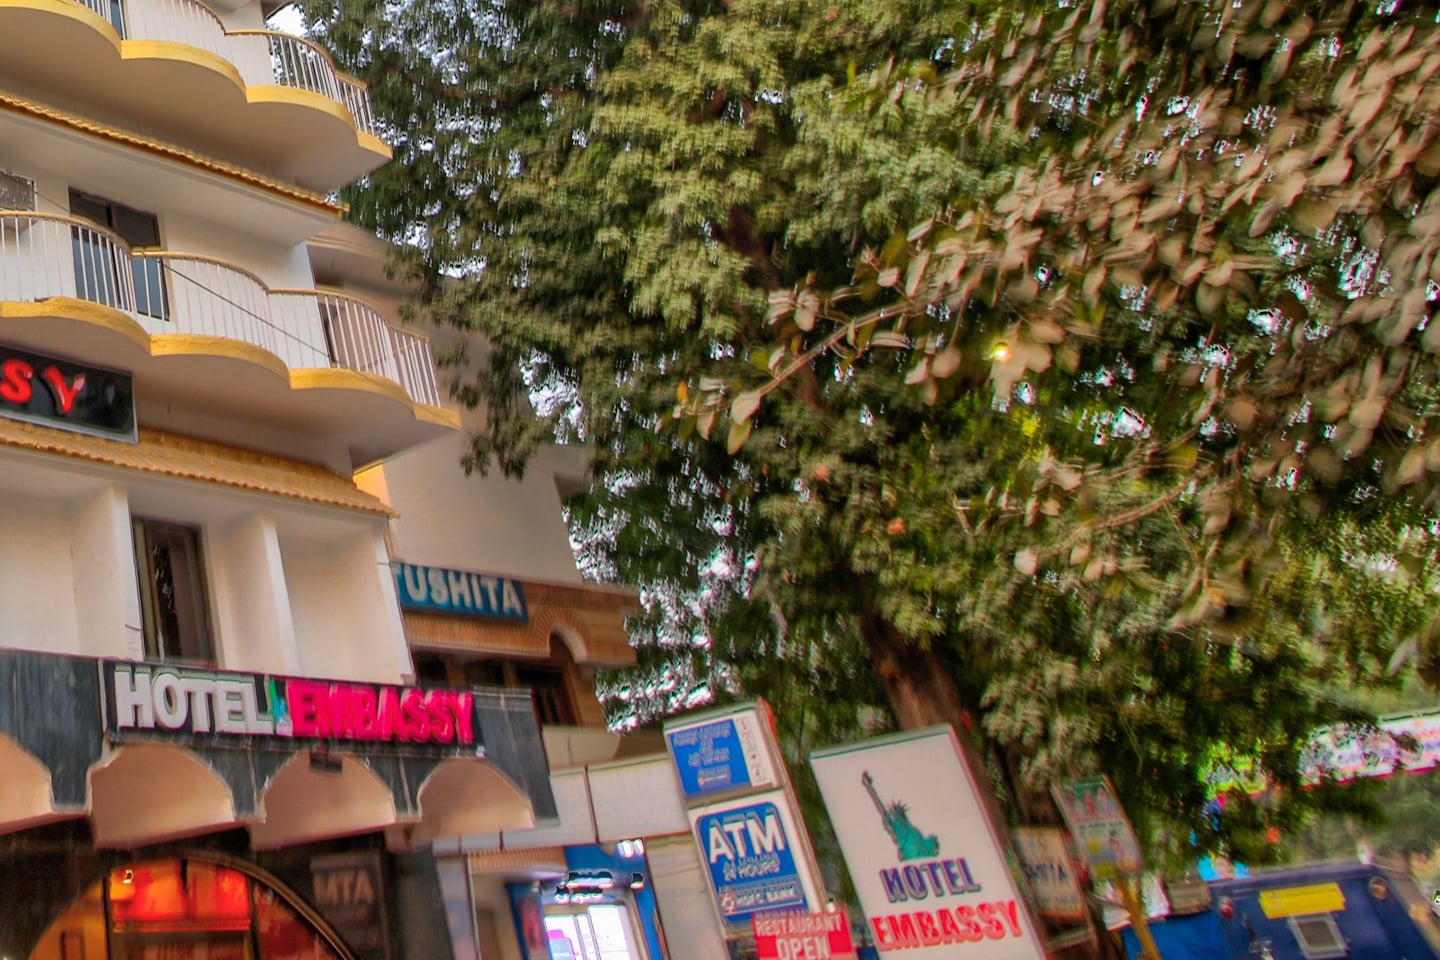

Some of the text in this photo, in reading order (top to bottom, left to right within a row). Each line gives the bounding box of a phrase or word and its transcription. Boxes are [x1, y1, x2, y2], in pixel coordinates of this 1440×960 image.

[113, 662, 475, 745] HOTEL EMBASSY
[709, 808, 785, 864] ATM
[879, 856, 982, 903] HOTEL
[775, 935, 831, 960] OPEN
[869, 899, 1024, 952] EMBASSY
